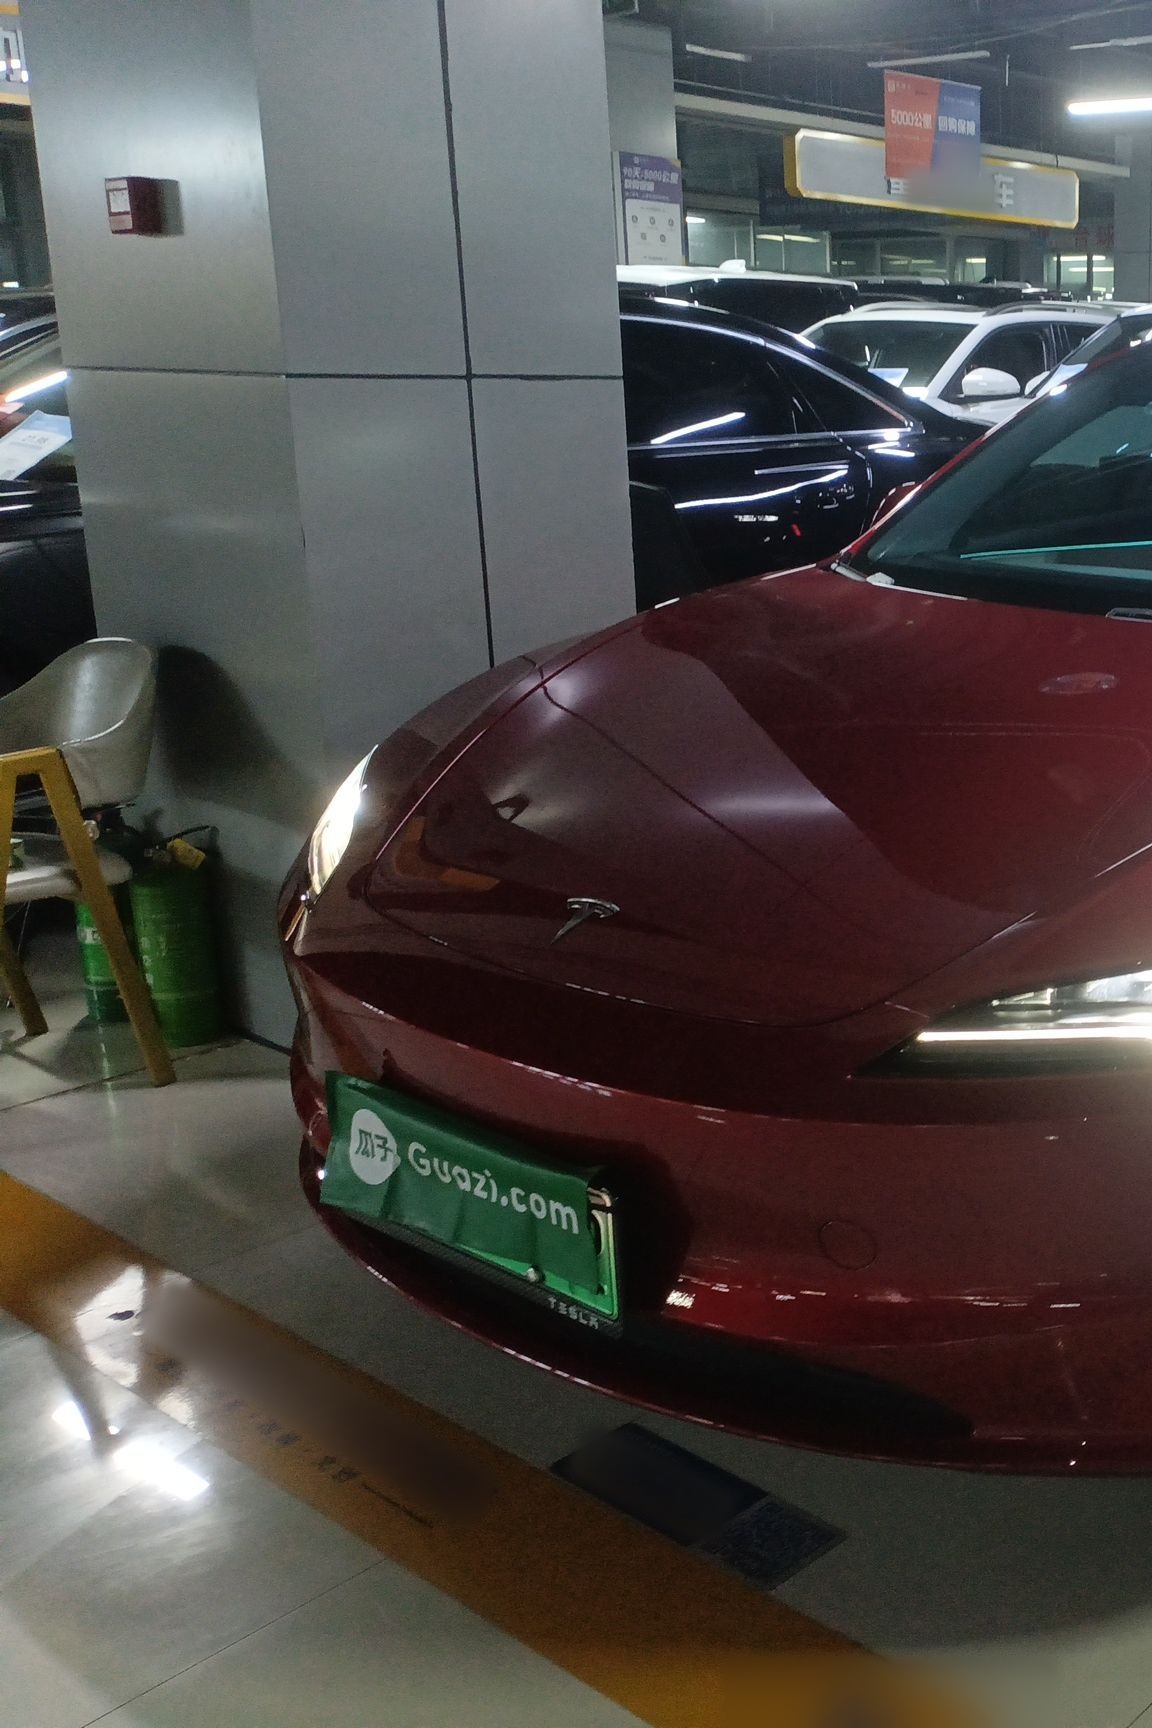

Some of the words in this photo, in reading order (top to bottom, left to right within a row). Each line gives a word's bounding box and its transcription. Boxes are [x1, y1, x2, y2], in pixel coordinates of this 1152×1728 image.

[355, 1128, 393, 1162] 瓜子
[407, 1141, 579, 1234] Guazi.com
[548, 1296, 599, 1330] TESLA
